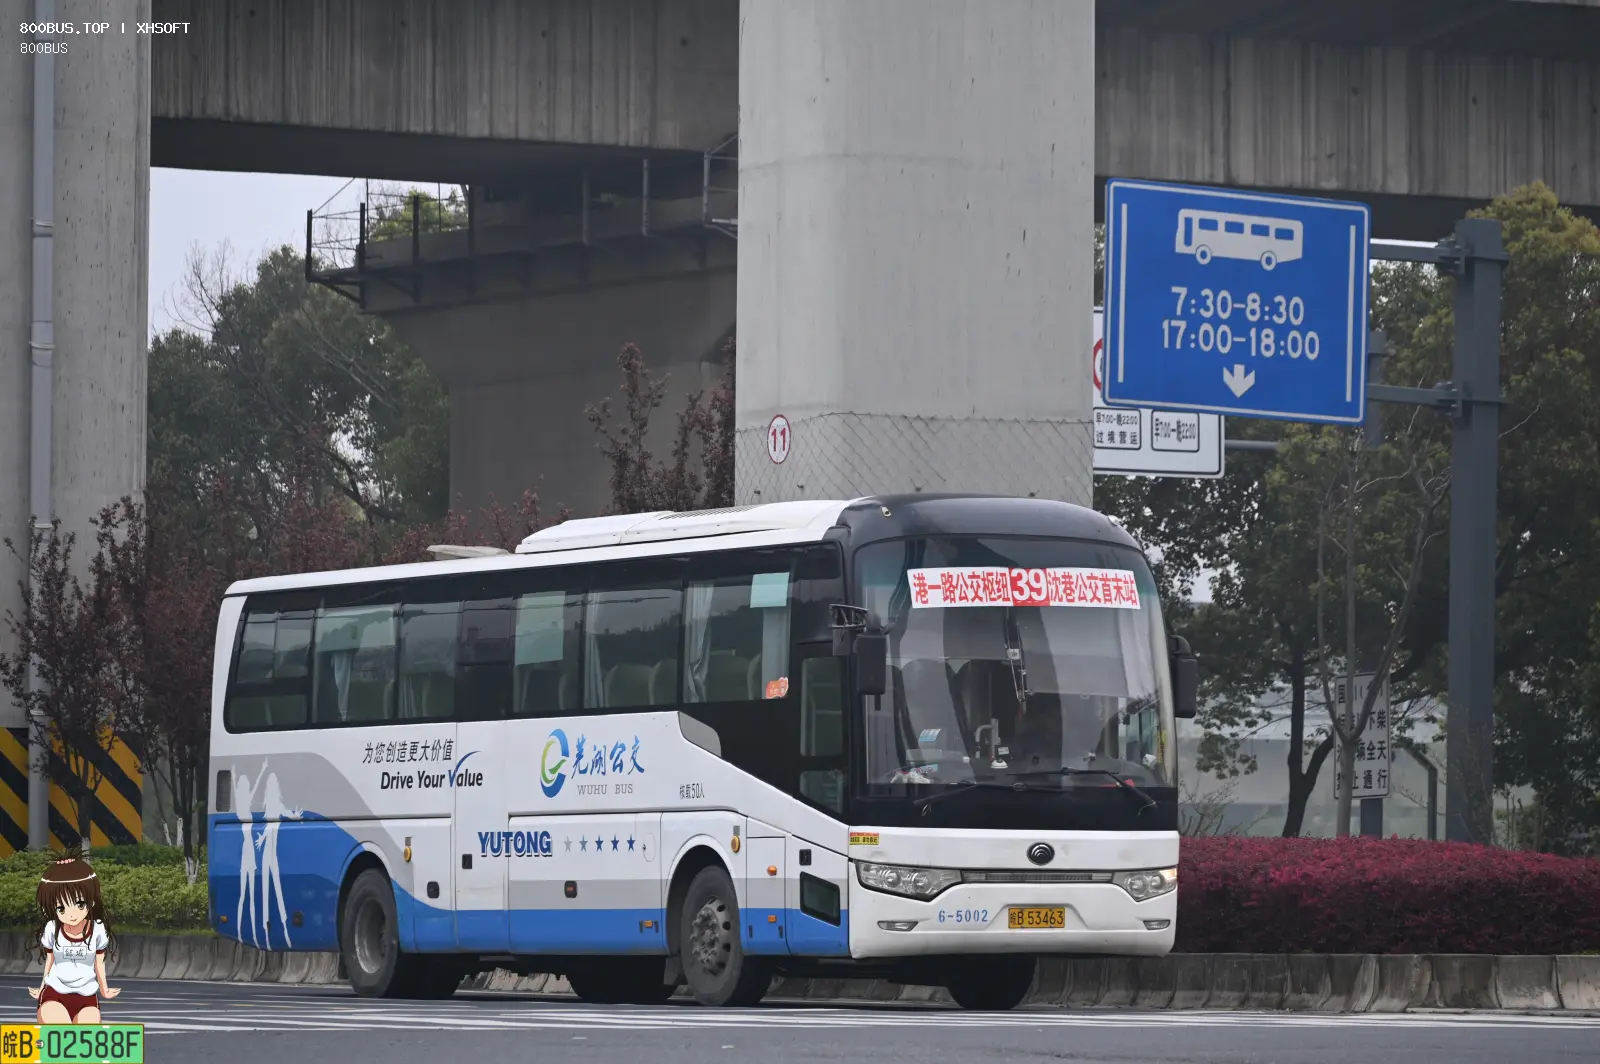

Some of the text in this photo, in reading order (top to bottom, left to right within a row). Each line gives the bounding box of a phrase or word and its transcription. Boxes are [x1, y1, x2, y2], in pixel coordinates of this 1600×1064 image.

[1171, 285, 1305, 326] 7:30-8:30
[1162, 319, 1320, 361] 17:00-18:00
[771, 427, 787, 452] 11
[913, 568, 1138, 606] 港一路公交枢纽 39 沈巷公交首末站
[362, 738, 454, 764] 为您创造更大价值
[570, 734, 645, 779] 芜湖公交
[380, 756, 483, 790] Drive Your Value
[577, 783, 634, 795] WUHU BUS
[478, 830, 554, 858] YUTONG
[938, 908, 989, 924] 6-5002
